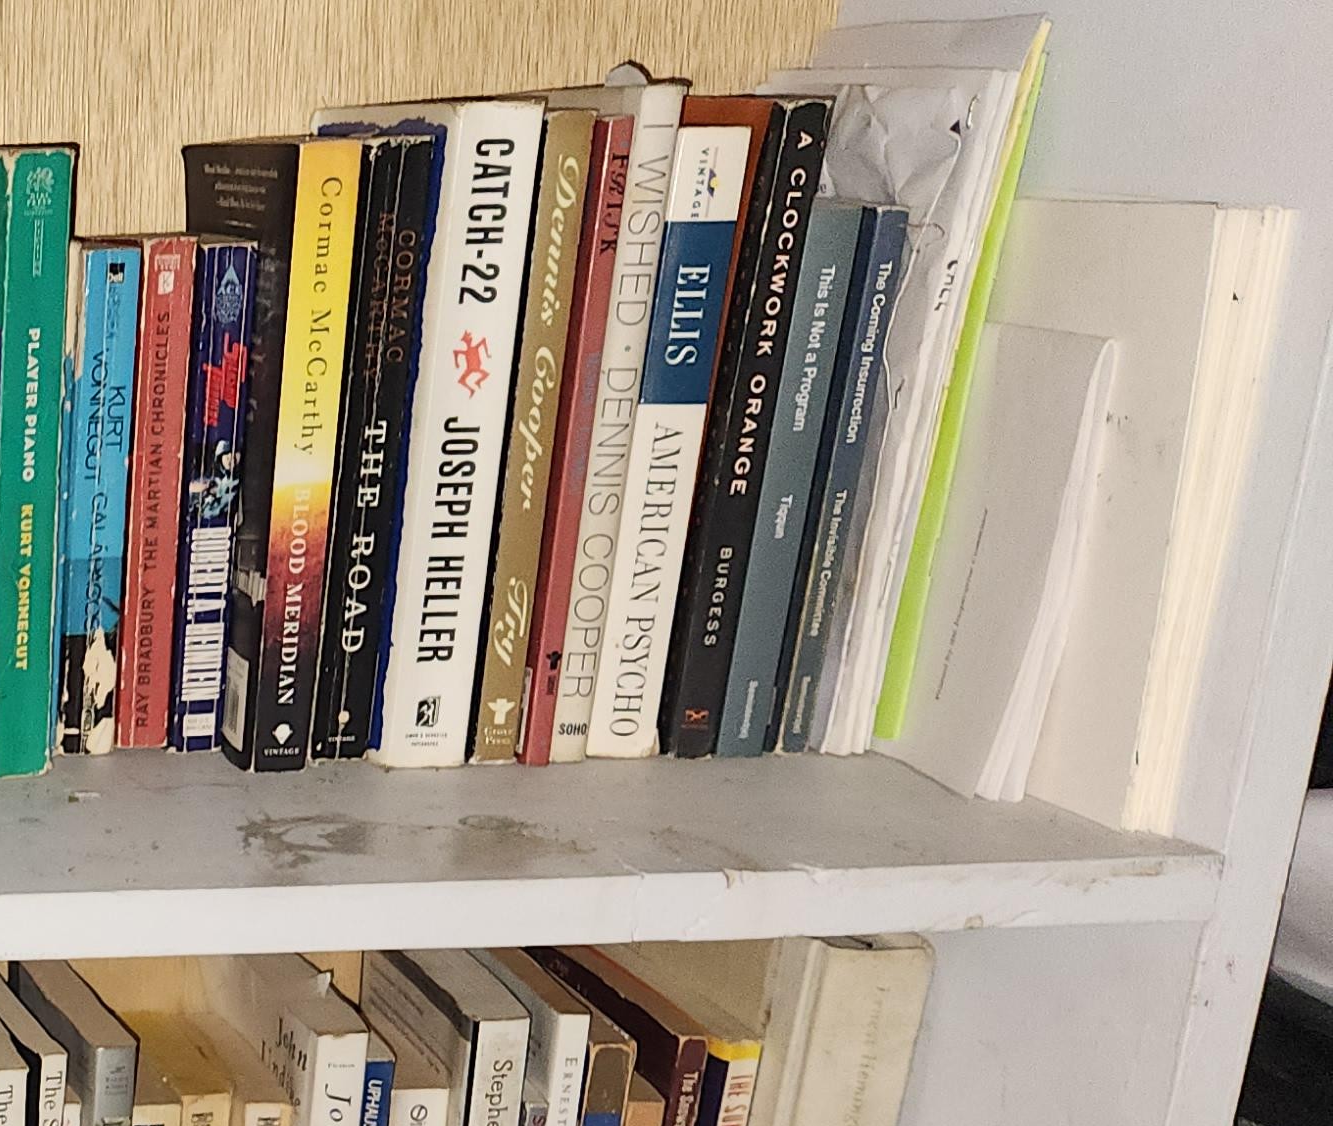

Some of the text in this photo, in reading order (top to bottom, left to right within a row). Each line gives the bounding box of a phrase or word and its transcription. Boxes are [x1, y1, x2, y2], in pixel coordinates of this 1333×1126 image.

[458, 139, 515, 305] CATCH-22
[664, 263, 711, 367] ELLIS
[729, 131, 813, 497] A CLOCKWORK ORANGE
[278, 489, 310, 706] BLOOD MERIDIAN
[416, 416, 480, 664] JOSEPH HELLER
[609, 423, 684, 738] AMERICAN PSYCHO
[703, 546, 733, 647] BURGESS
[263, 746, 299, 757] VINTAGE
[558, 723, 587, 736] SOHO
